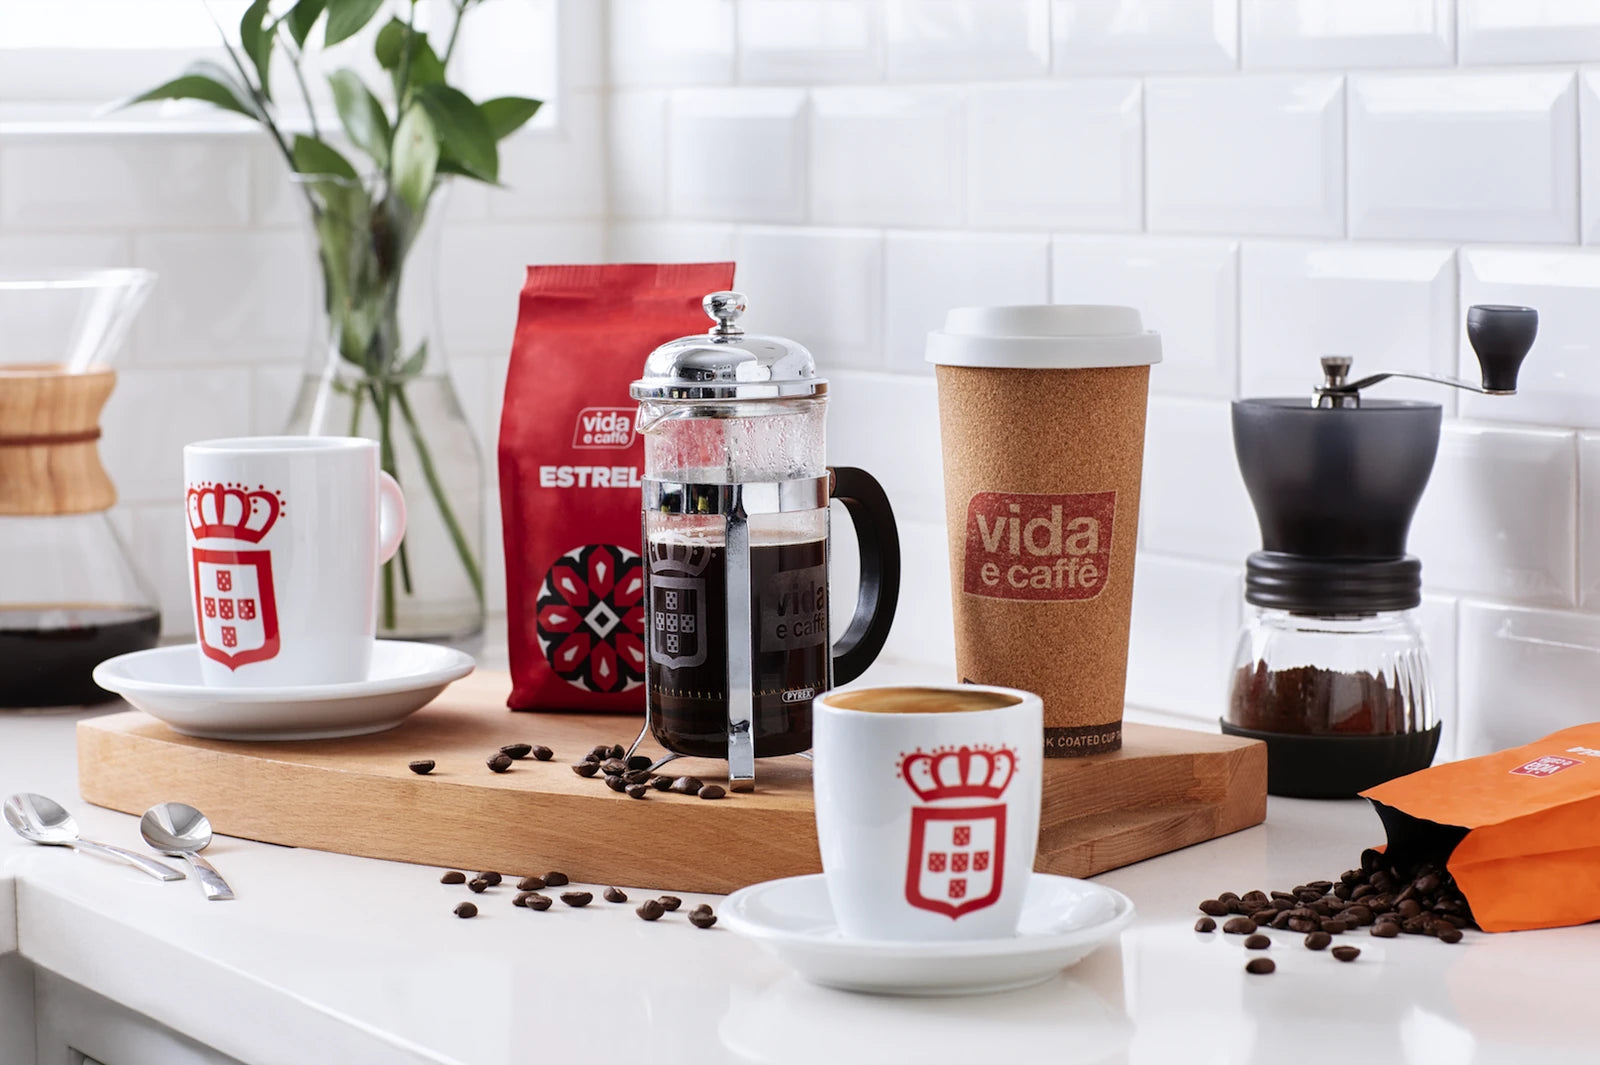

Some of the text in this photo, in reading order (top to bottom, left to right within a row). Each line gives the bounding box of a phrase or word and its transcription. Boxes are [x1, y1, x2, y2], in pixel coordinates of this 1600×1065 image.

[582, 411, 630, 432] vida
[583, 433, 593, 444] e
[975, 503, 1099, 557] vida
[980, 562, 1000, 585] e
[776, 580, 824, 617] vida
[776, 623, 788, 639] e
[787, 690, 811, 701] PYREX
[1058, 735, 1100, 748] COATED
[1101, 732, 1116, 744] CUP
